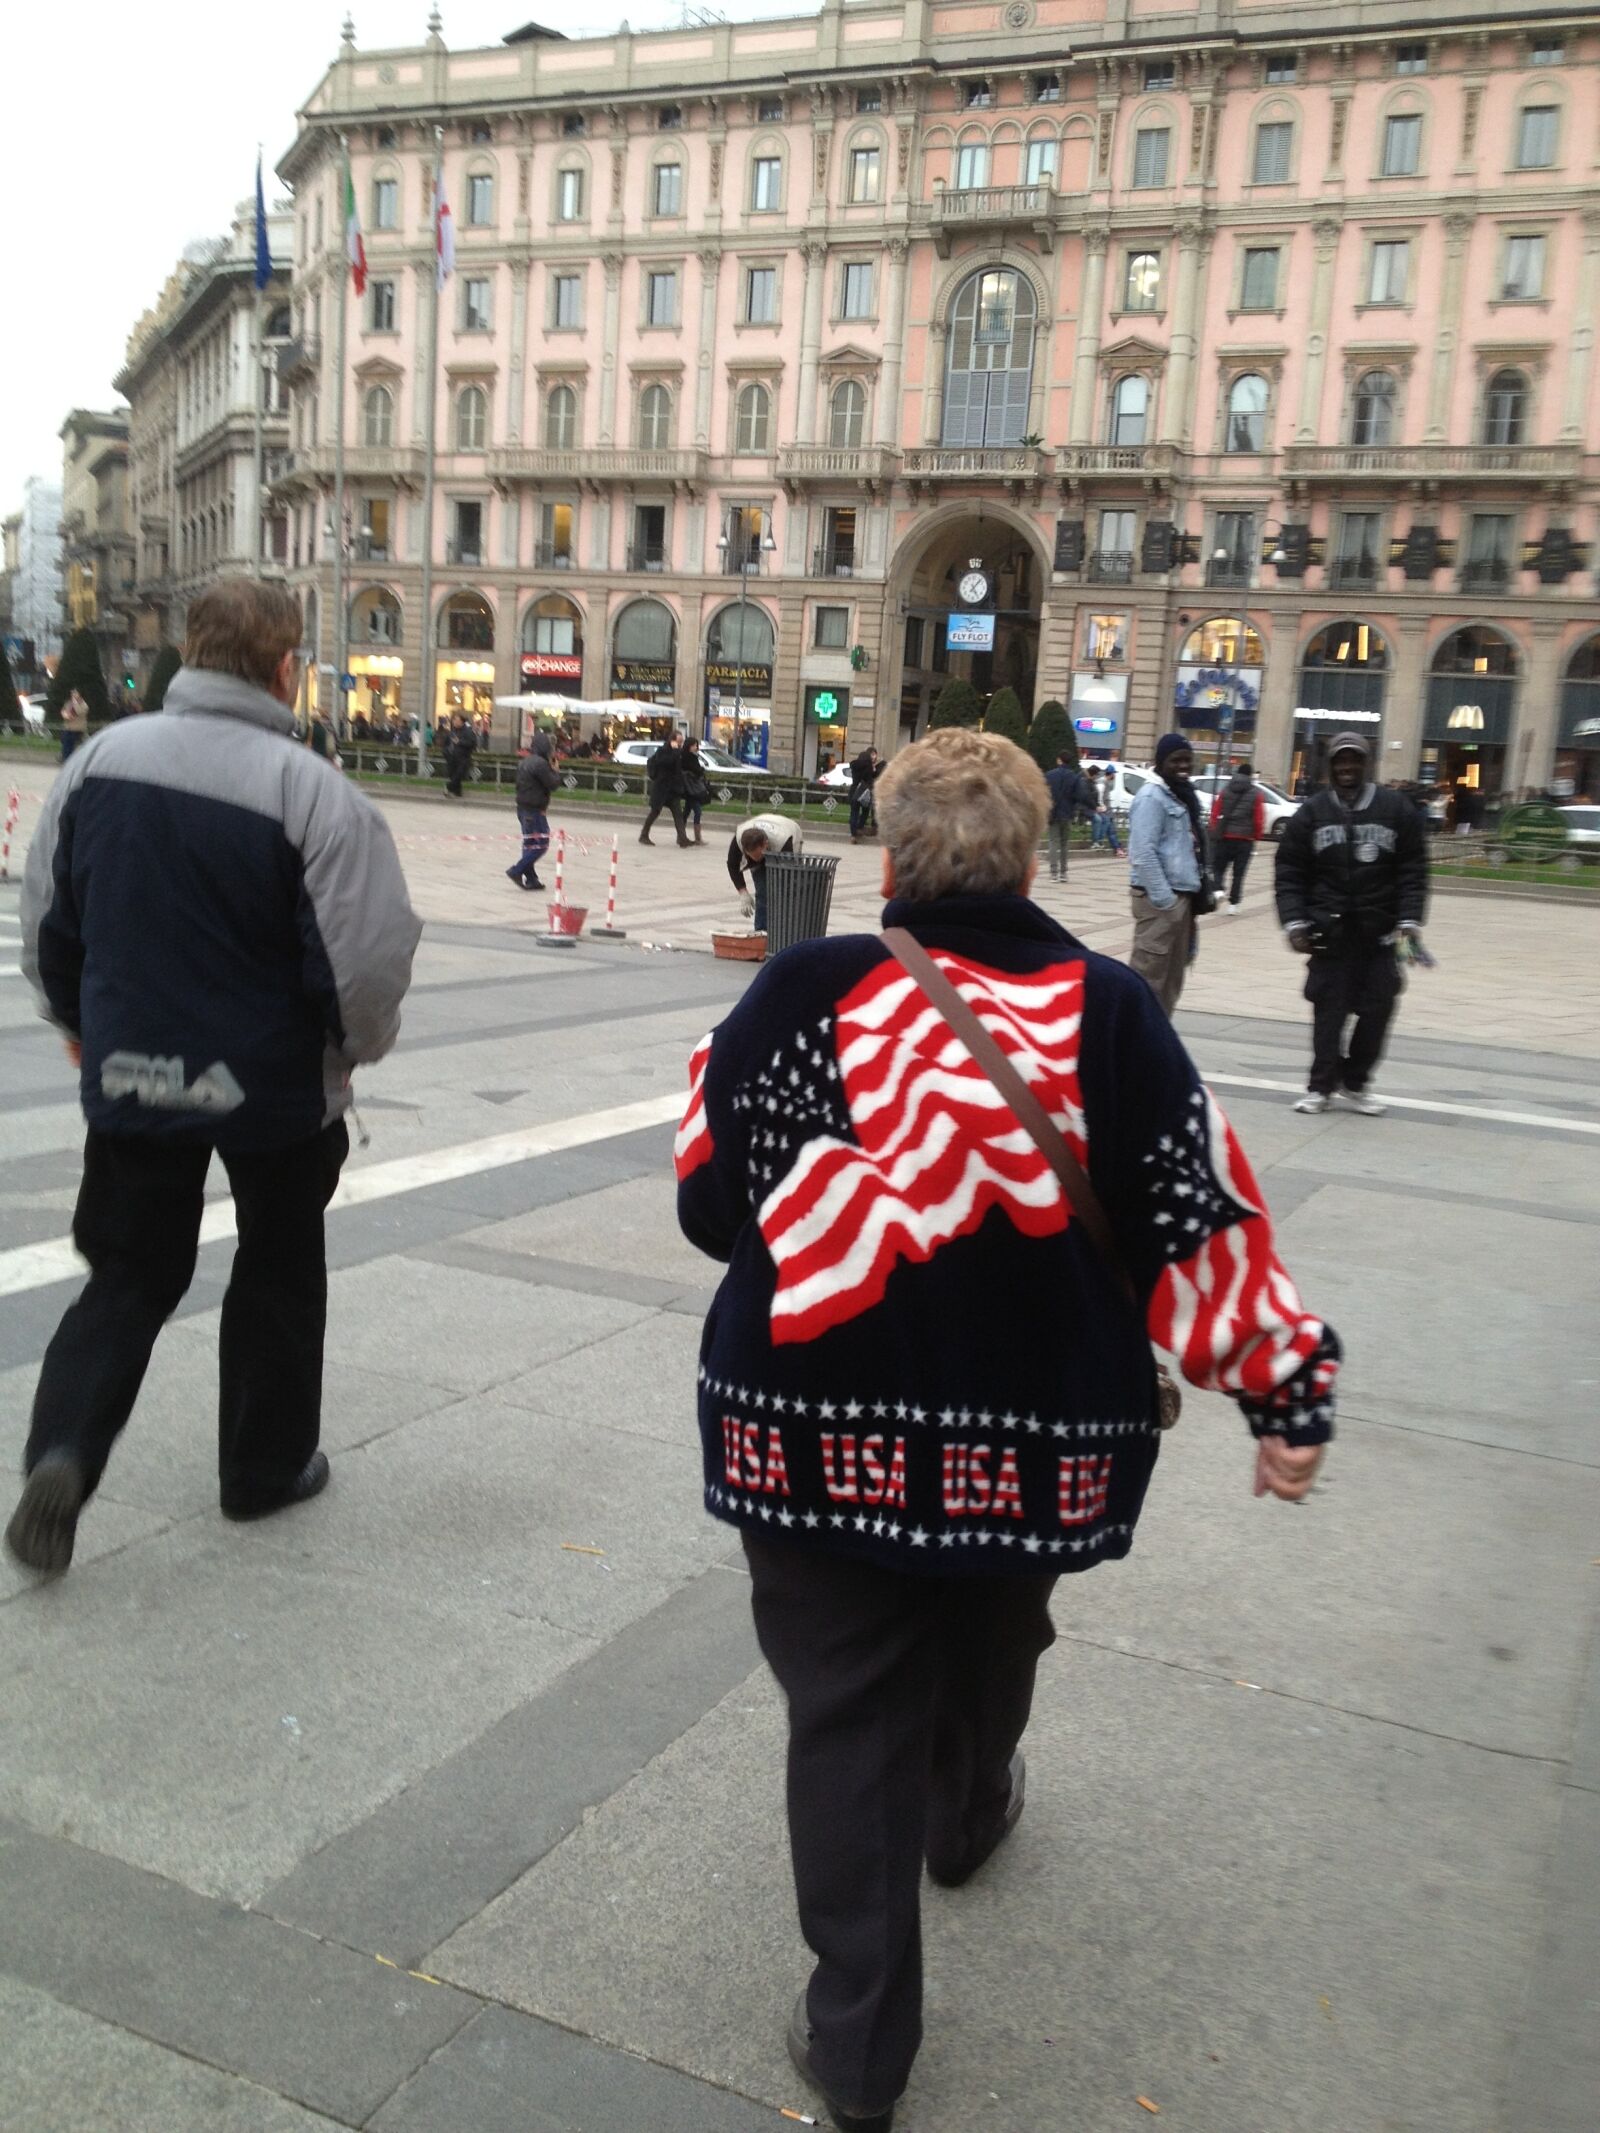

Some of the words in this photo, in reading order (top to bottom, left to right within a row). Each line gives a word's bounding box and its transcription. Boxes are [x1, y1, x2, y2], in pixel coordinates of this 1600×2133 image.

[952, 632, 967, 641] FLY
[968, 633, 988, 641] FLOT
[1313, 825, 1347, 852] NEW
[1352, 824, 1397, 852] YORK
[722, 1415, 791, 1496] USA
[820, 1432, 907, 1510] USA
[942, 1442, 1025, 1519] USA
